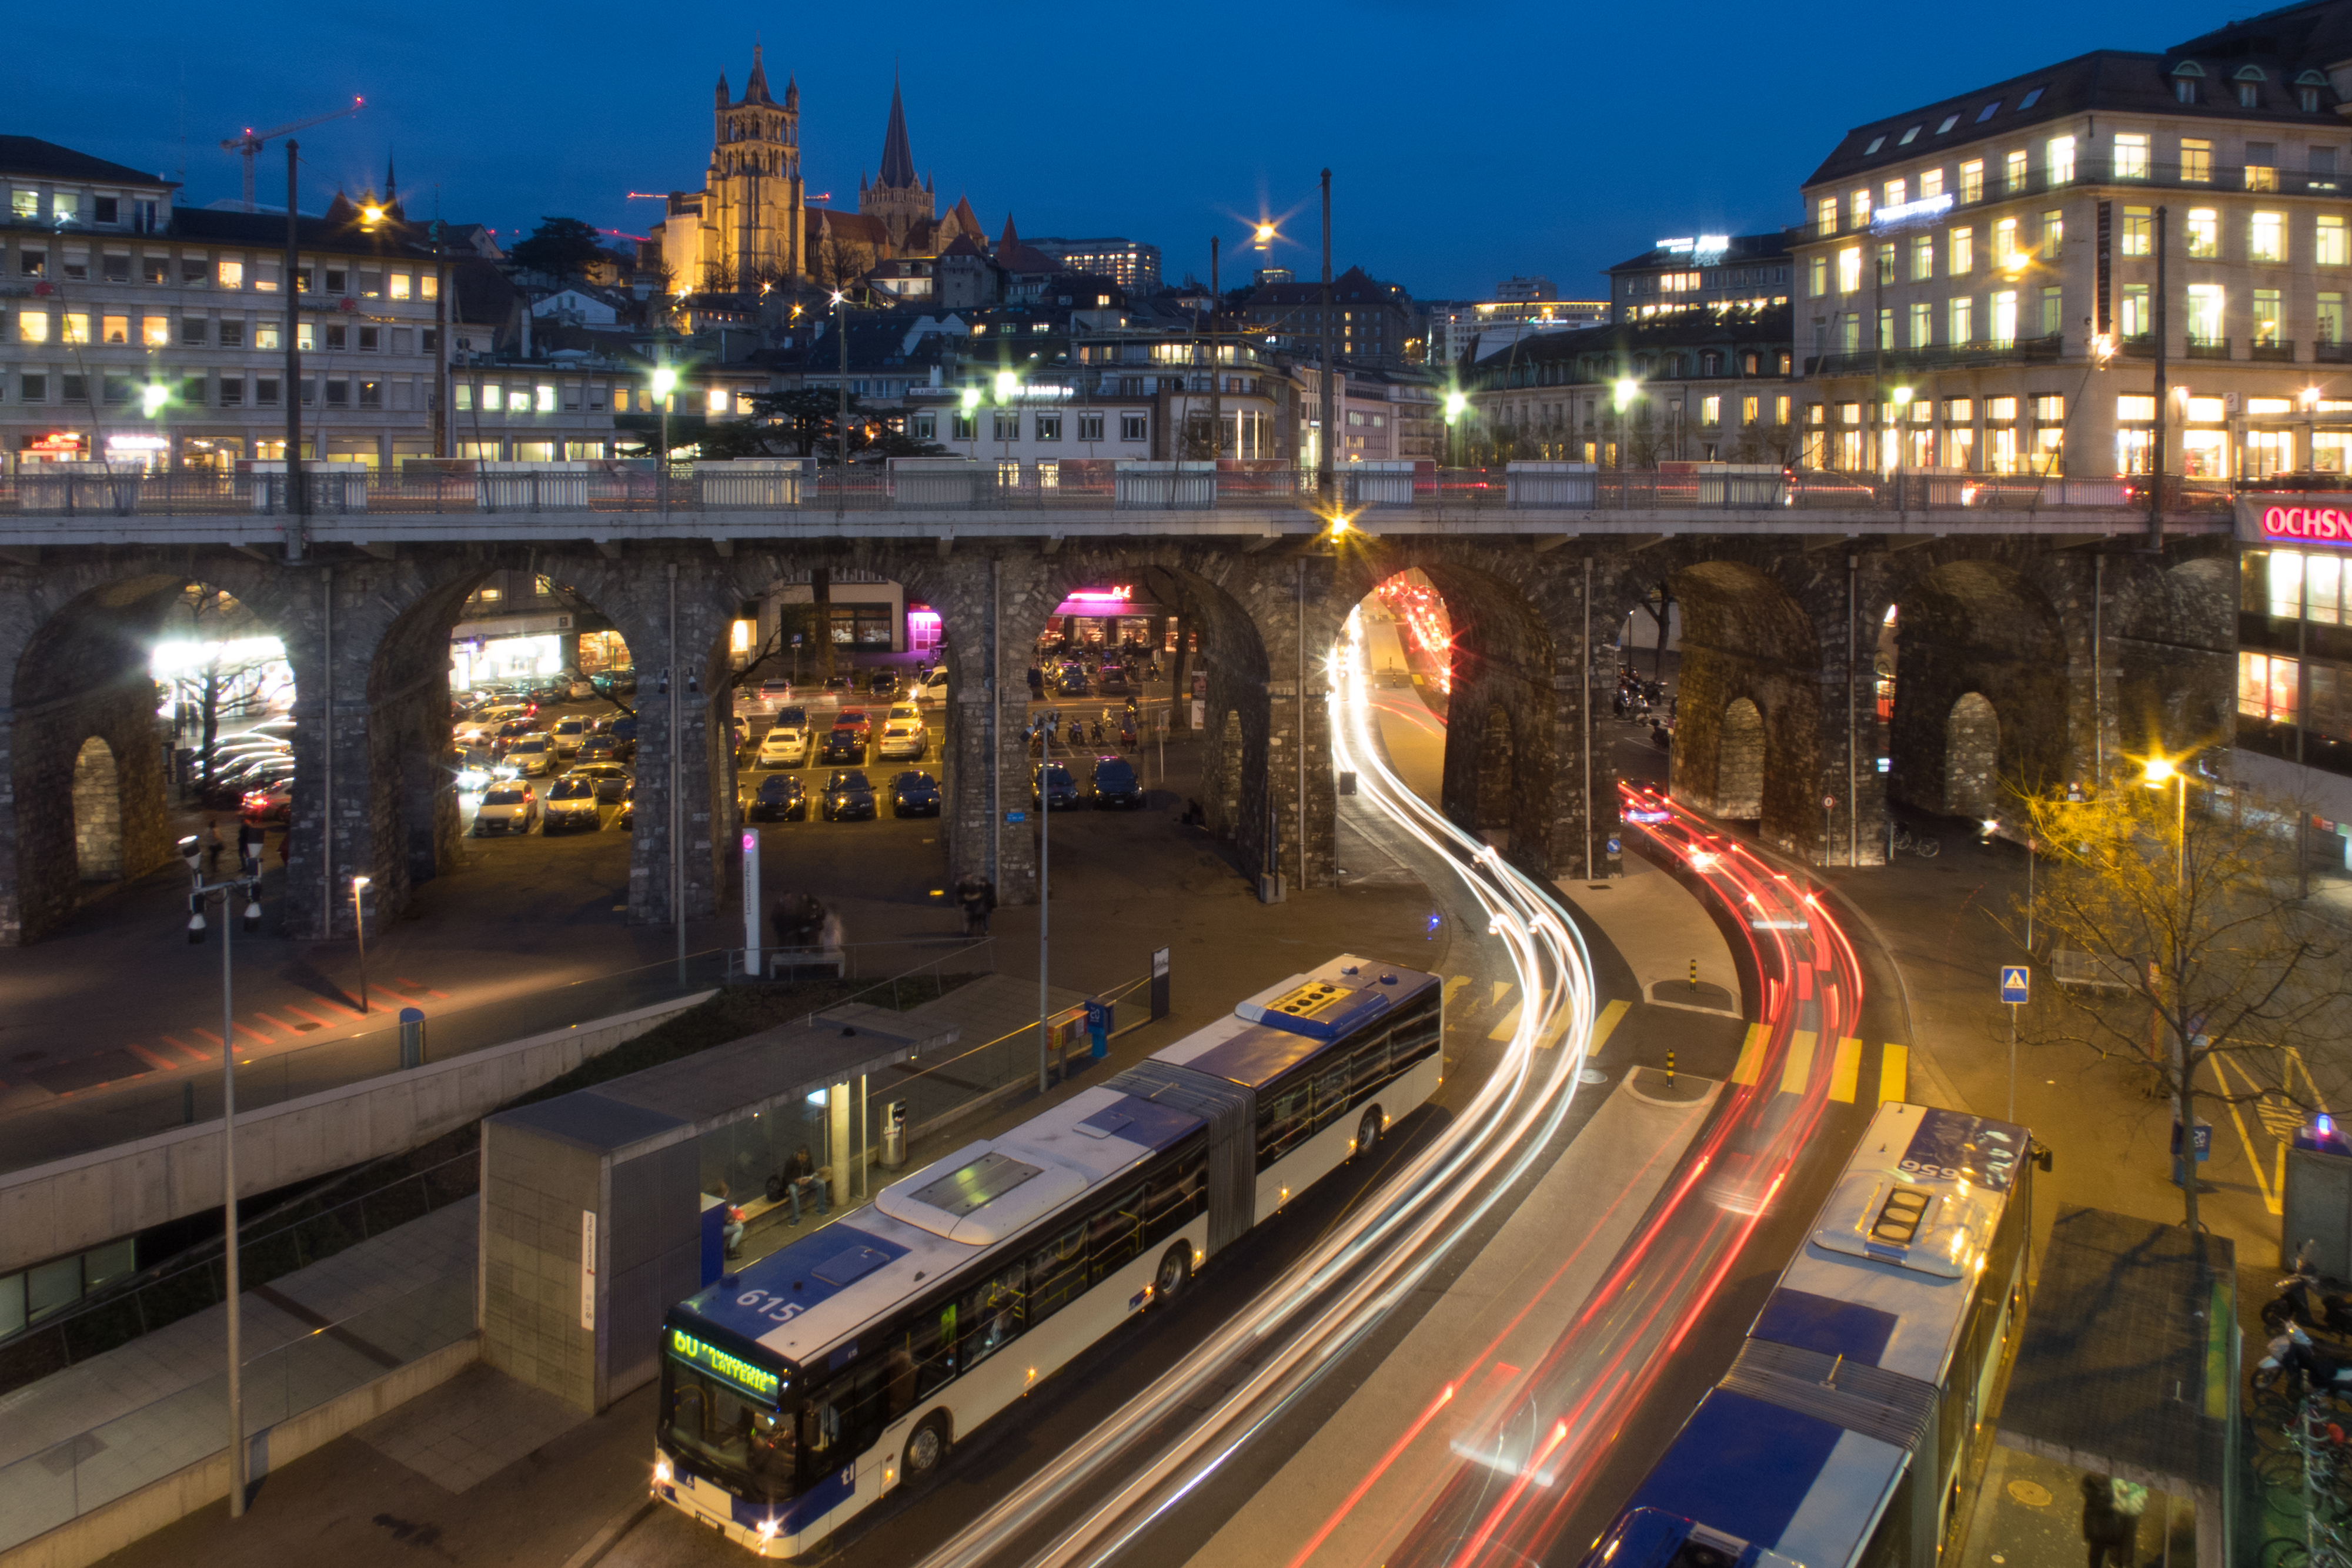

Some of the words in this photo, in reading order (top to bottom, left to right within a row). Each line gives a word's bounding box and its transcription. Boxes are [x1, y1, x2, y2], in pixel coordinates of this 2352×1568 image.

[1027, 385, 1060, 395] BRAUN
[1899, 1160, 1961, 1181] 656
[736, 1289, 804, 1321] 615
[711, 1353, 767, 1392] LAITERIE
[841, 1461, 855, 1486] tl
